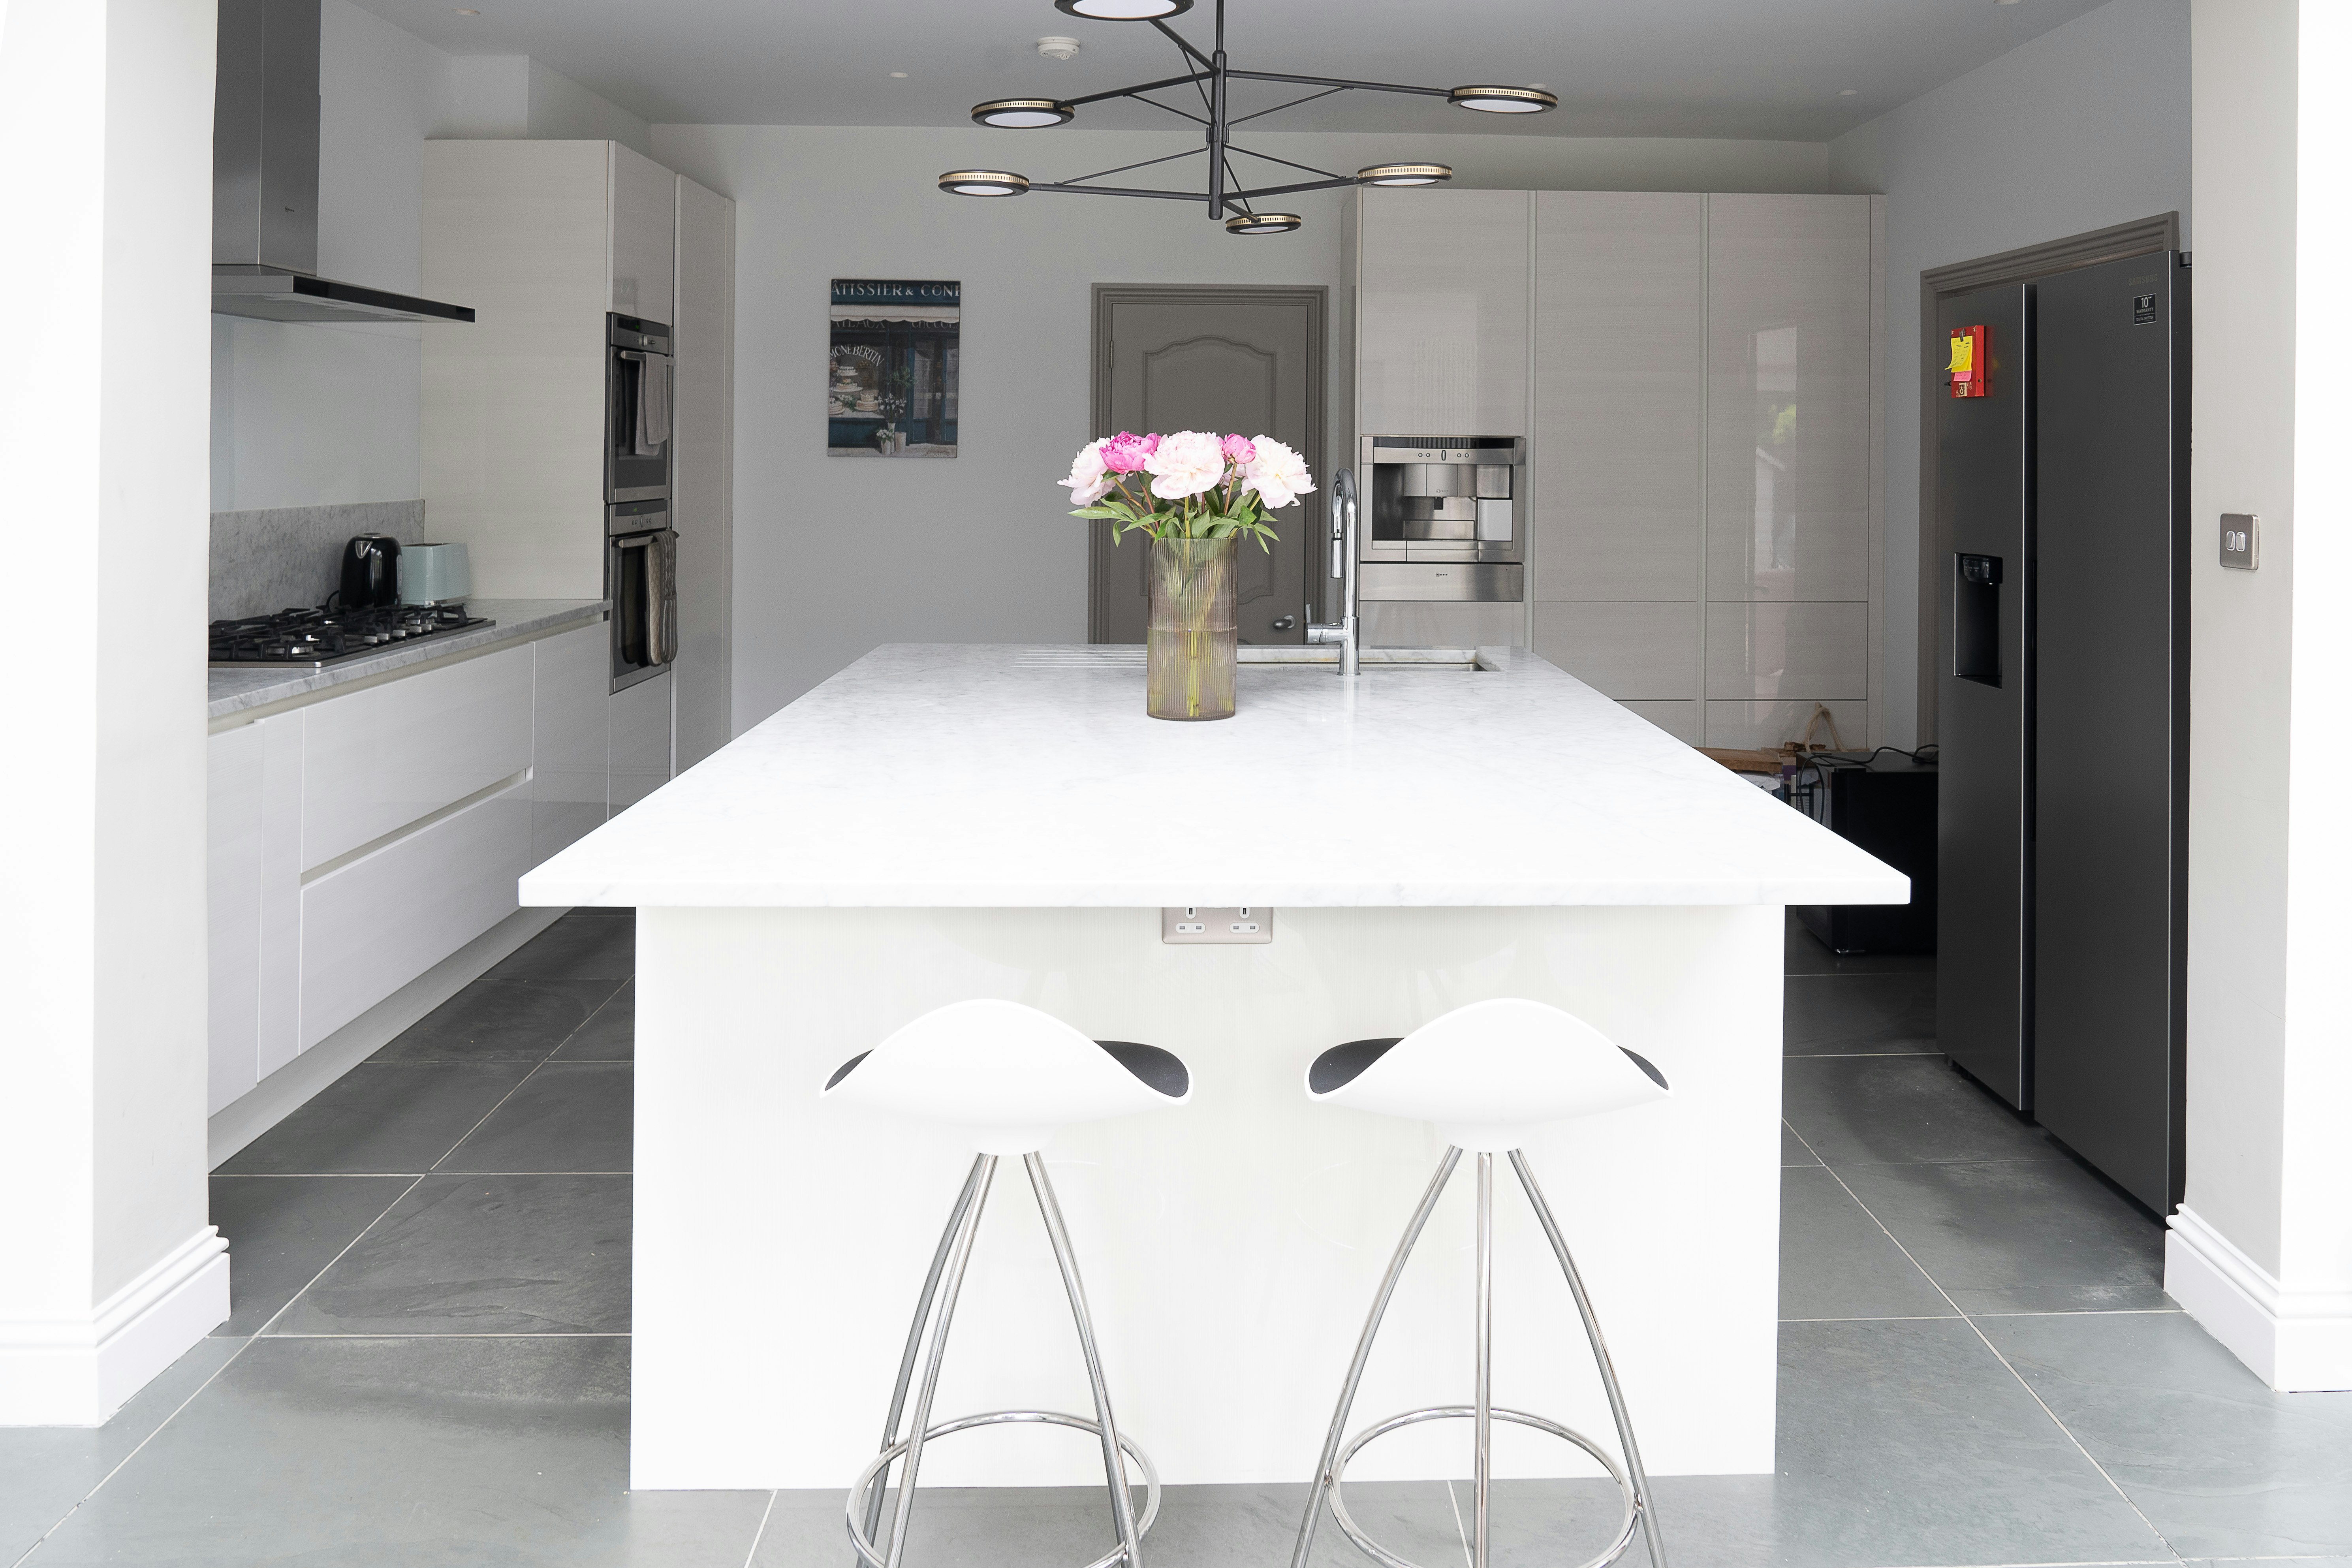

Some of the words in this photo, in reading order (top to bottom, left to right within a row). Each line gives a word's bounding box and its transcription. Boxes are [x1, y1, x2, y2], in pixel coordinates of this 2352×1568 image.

[2128, 274, 2158, 286] SAMSUNG
[831, 280, 902, 296] ÂTISSIER
[905, 287, 914, 295] &
[2141, 297, 2149, 308] 10
[852, 345, 884, 367] BERTIN
